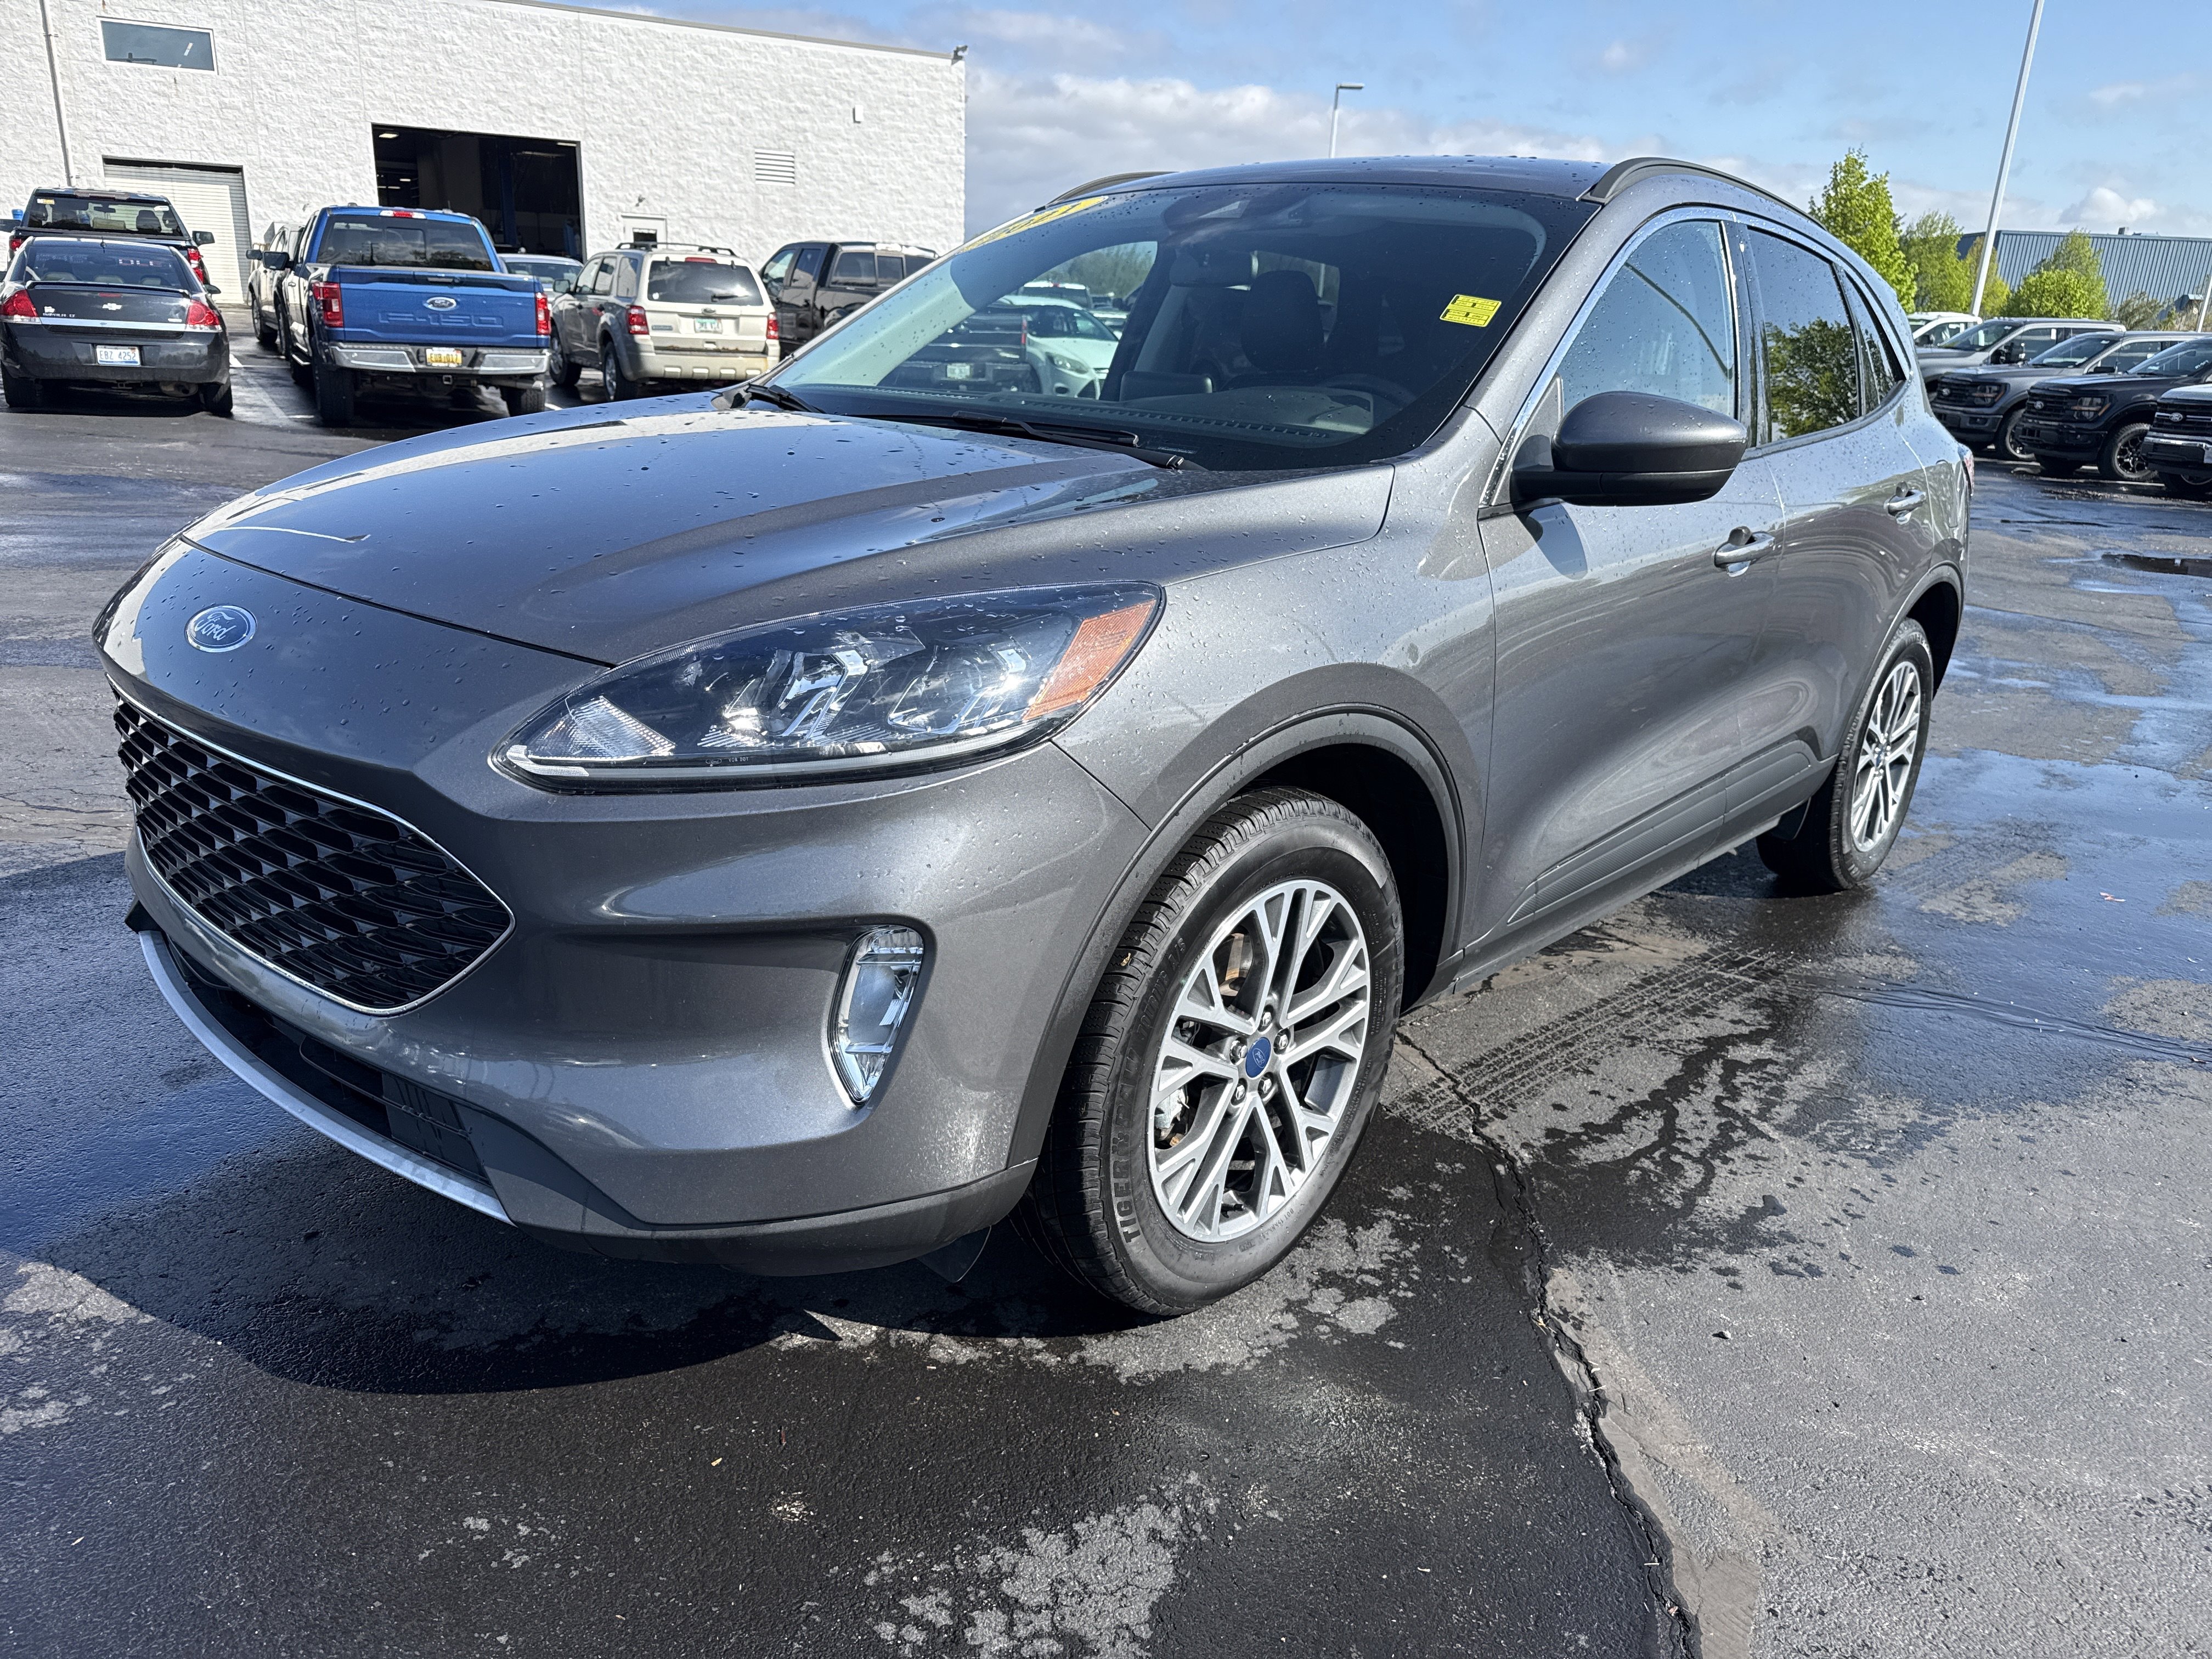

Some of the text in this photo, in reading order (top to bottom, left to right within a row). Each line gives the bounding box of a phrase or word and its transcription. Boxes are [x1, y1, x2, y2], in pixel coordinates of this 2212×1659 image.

[378, 312, 504, 328] F-150
[118, 351, 136, 360] 4252
[194, 611, 236, 641] Ford
[1113, 938, 1186, 1243] TIGER PAW TOURING A/S
[1284, 1208, 1294, 1220] DOT
